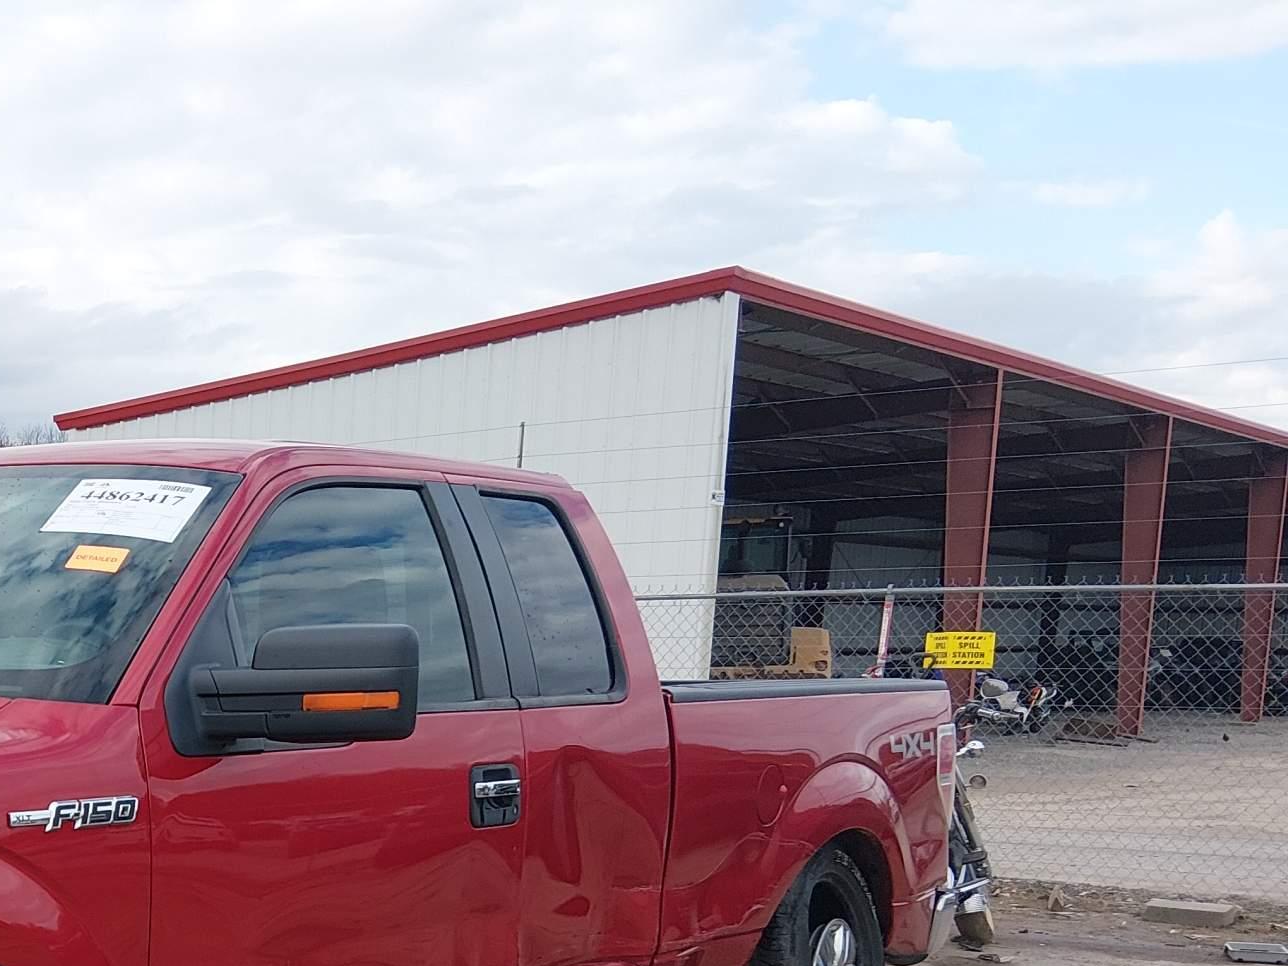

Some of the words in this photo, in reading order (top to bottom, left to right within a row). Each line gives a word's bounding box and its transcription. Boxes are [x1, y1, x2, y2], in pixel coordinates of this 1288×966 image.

[81, 490, 186, 505] 44862417
[75, 554, 118, 563] DETAILED
[958, 642, 980, 650] SPILL
[951, 651, 985, 659] STATION
[45, 796, 139, 831] F-150
